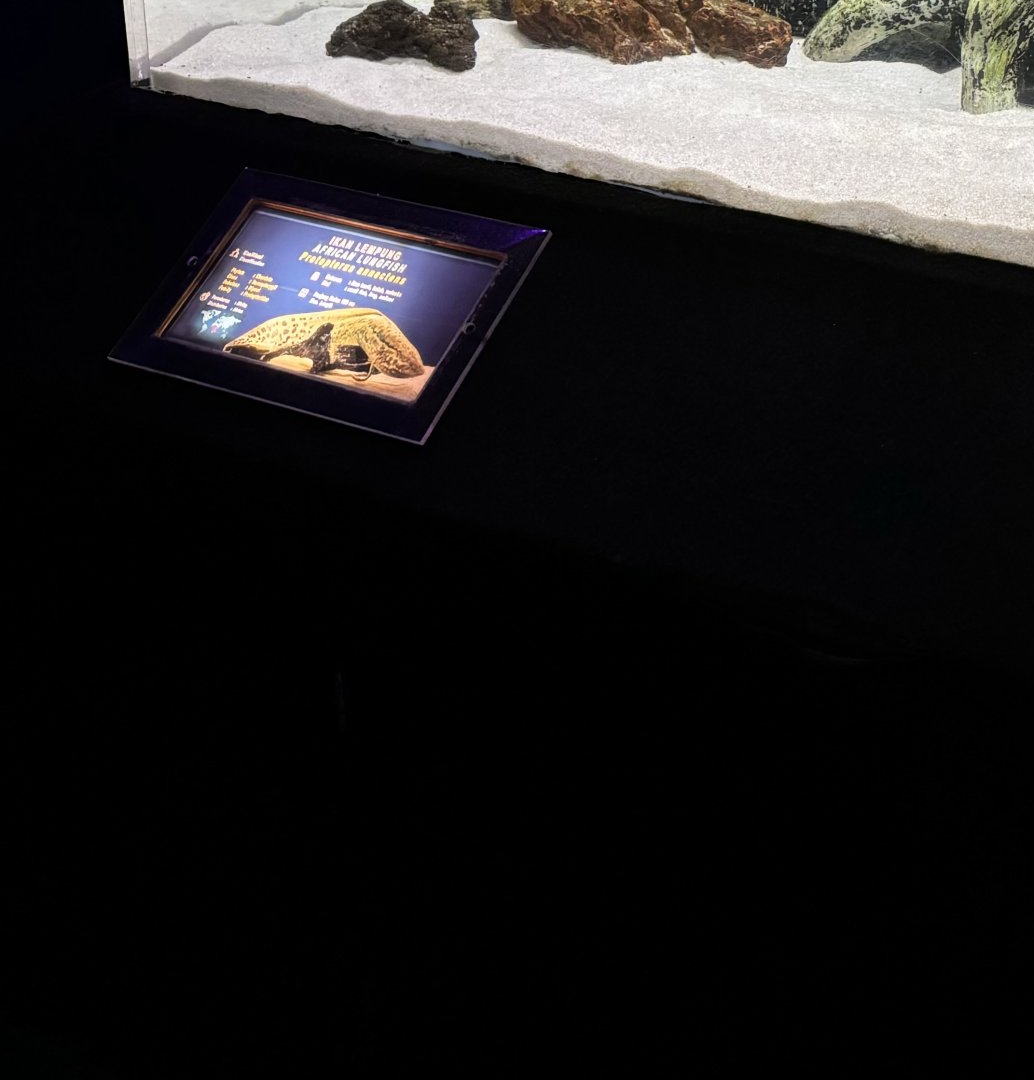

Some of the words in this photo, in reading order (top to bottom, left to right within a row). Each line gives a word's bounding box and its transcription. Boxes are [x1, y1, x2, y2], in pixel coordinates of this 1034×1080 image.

[312, 243, 356, 262] AFRICAN
[356, 254, 407, 273] LUNGFISH
[329, 236, 354, 250] IKAN
[355, 242, 402, 261] LEMPUNG
